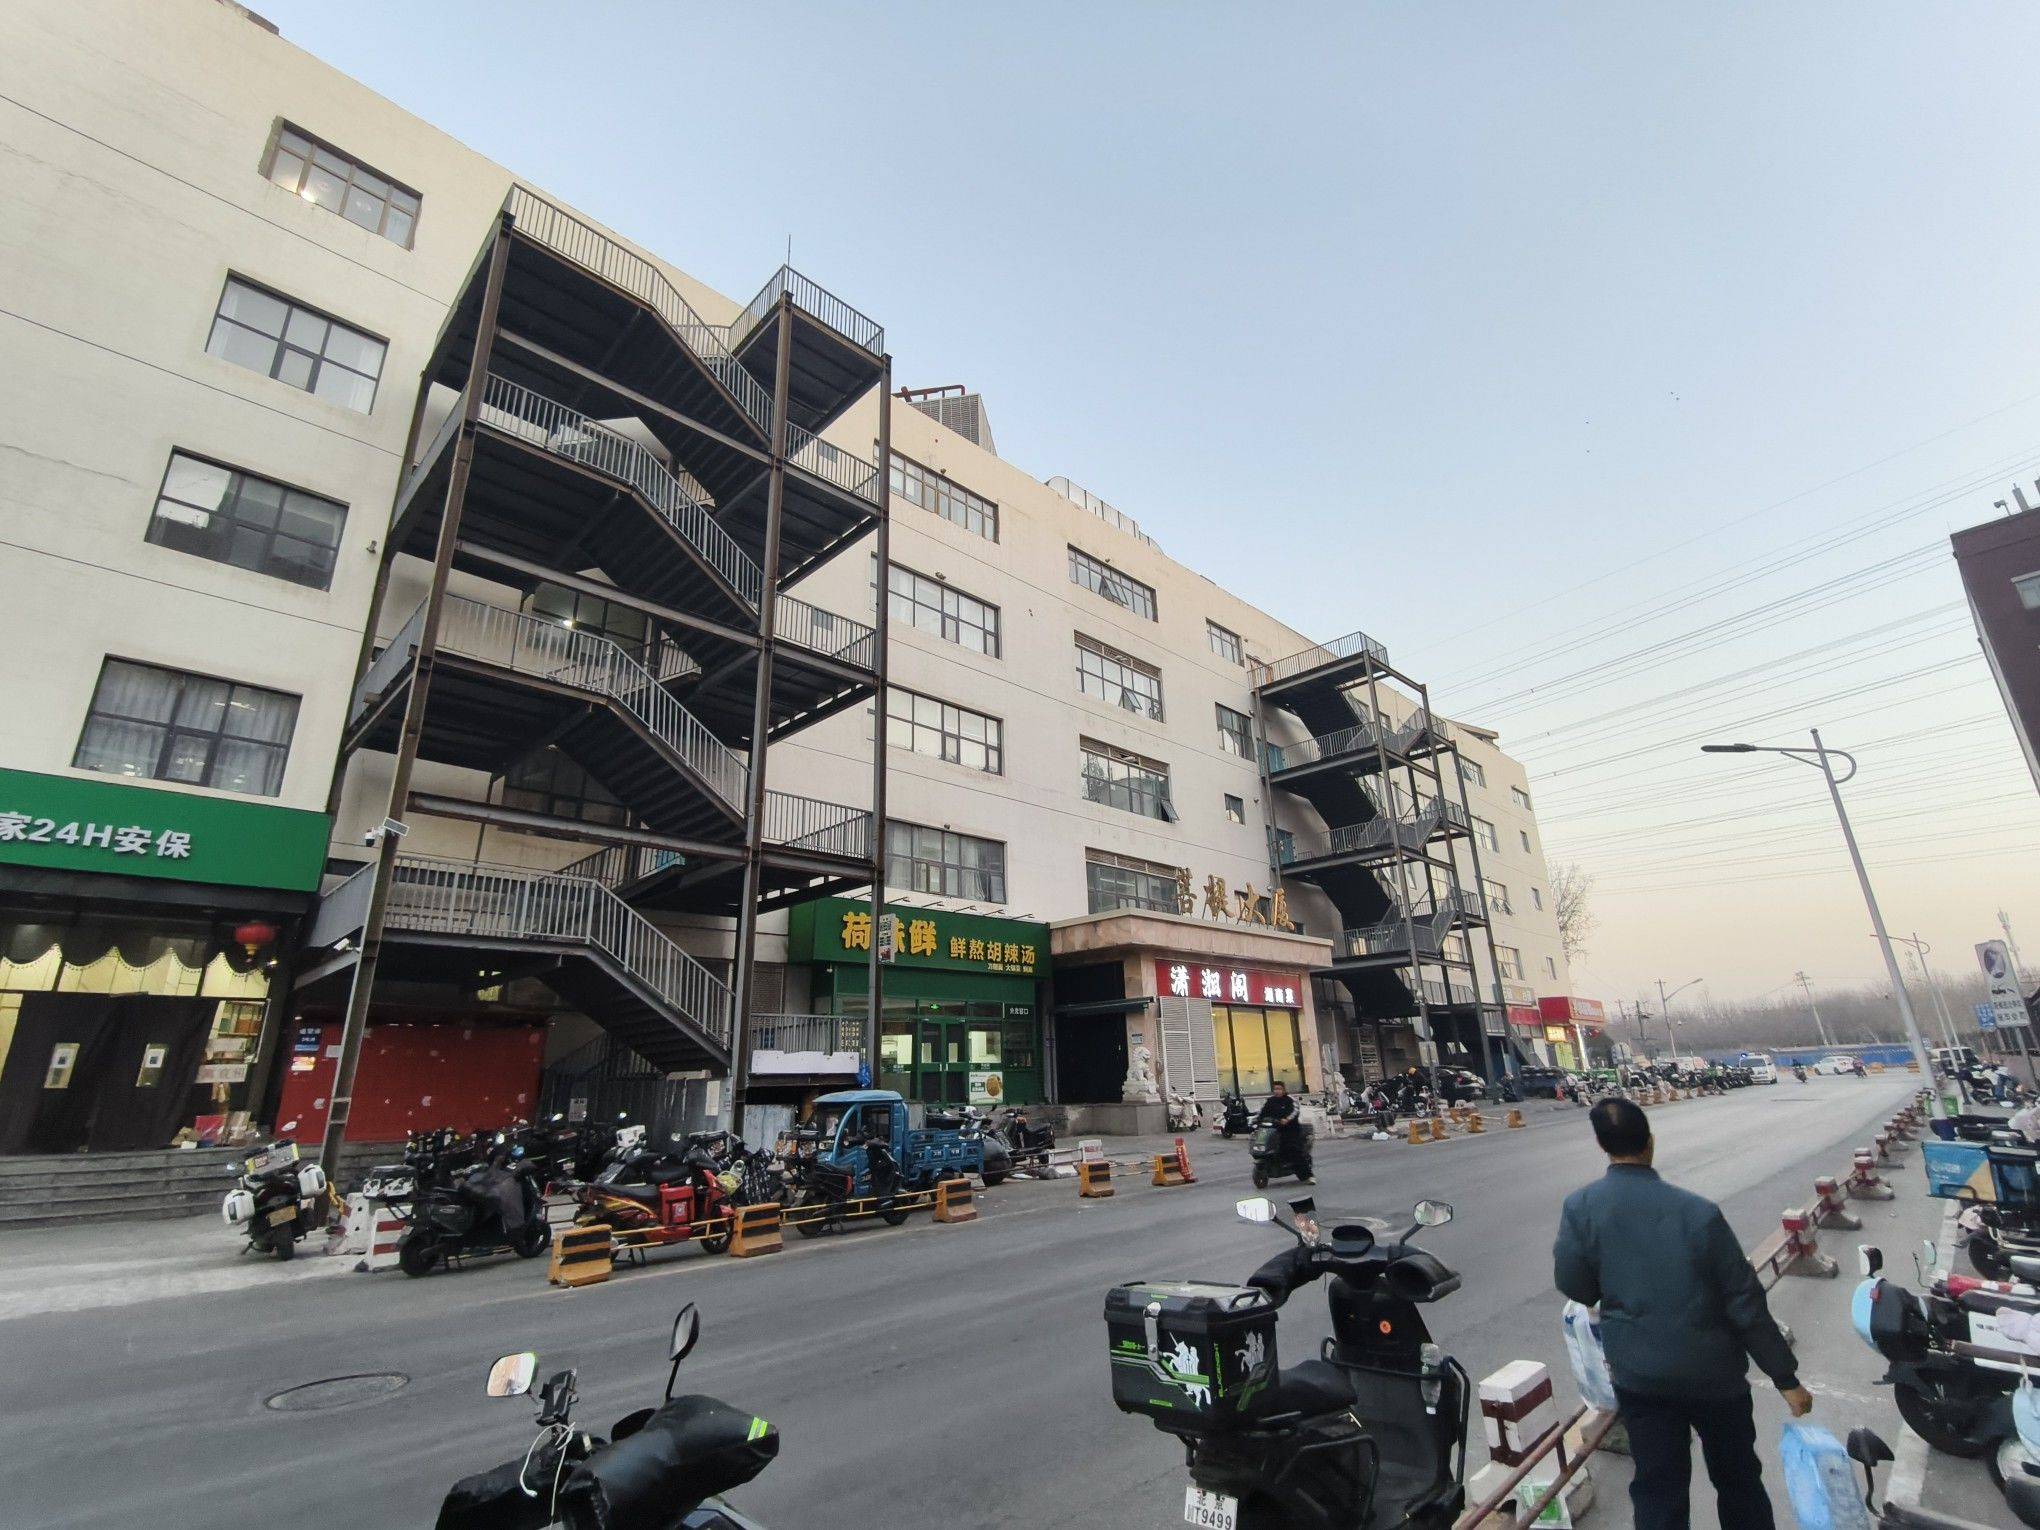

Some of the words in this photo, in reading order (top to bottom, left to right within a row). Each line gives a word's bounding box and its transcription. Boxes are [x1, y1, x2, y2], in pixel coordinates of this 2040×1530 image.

[0, 811, 191, 858] 家24H安保
[950, 937, 1035, 964] 鲜熬胡辣汤
[1171, 965, 1249, 1003] 潇湘阁
